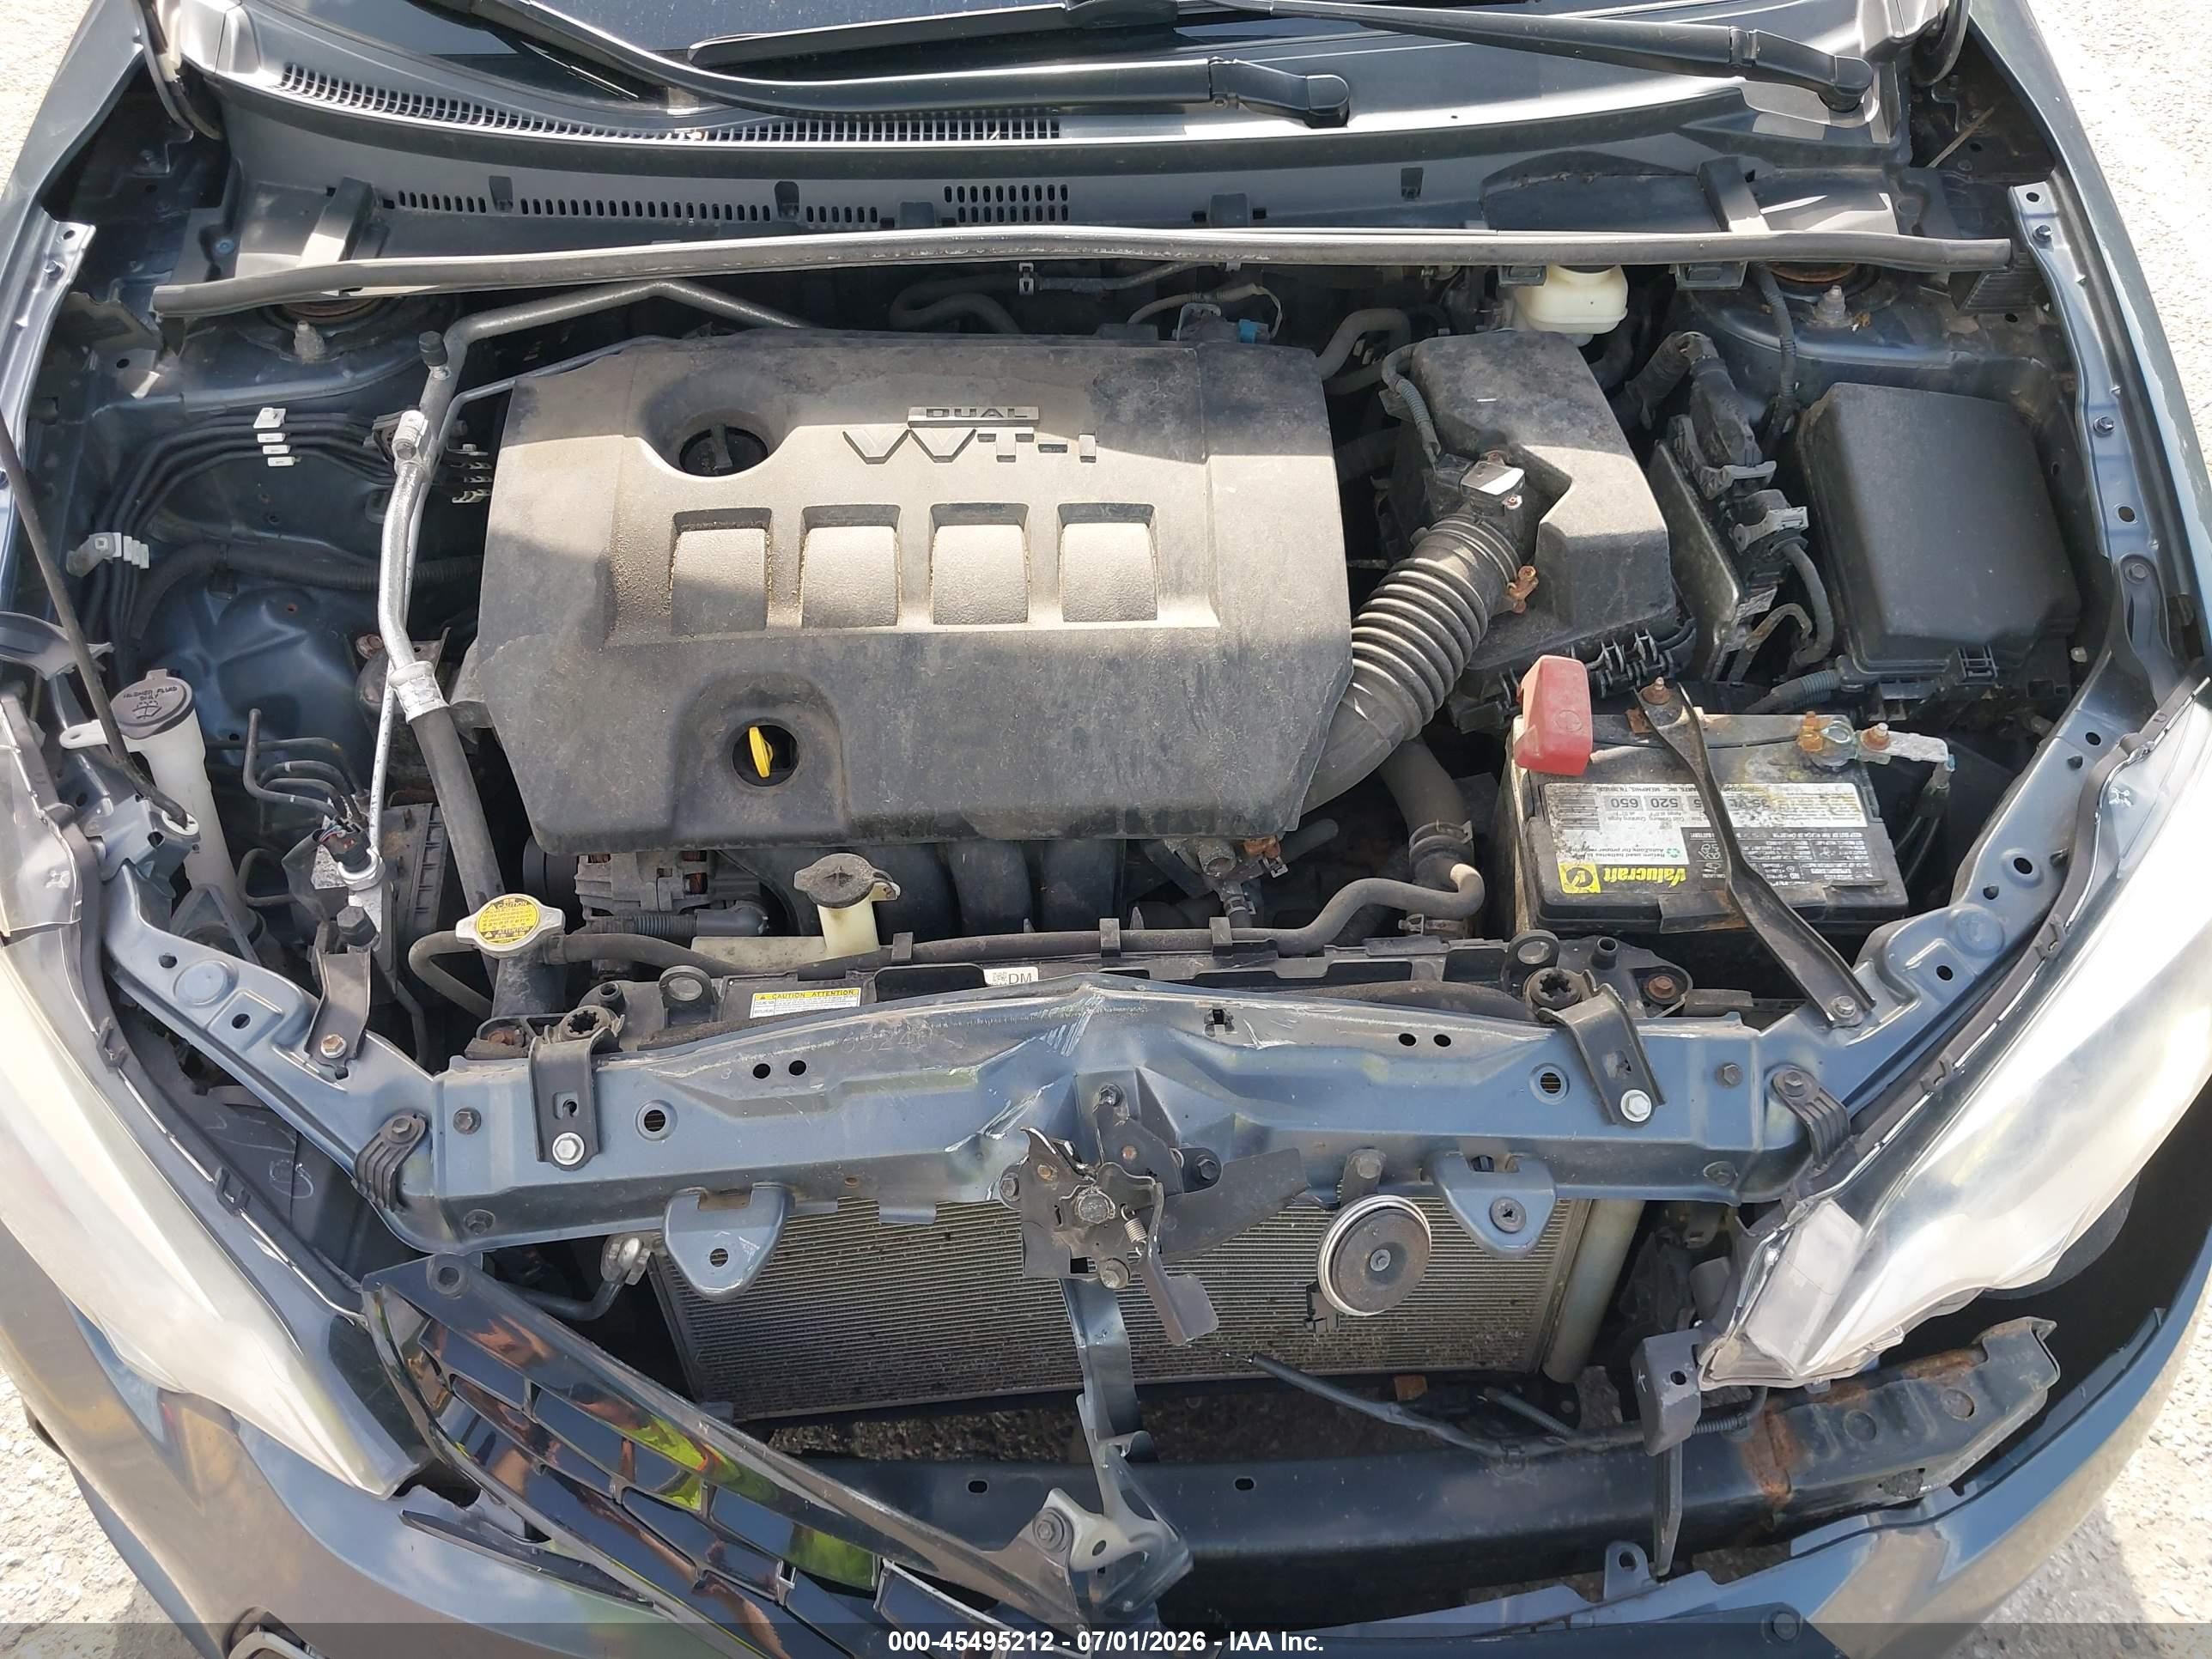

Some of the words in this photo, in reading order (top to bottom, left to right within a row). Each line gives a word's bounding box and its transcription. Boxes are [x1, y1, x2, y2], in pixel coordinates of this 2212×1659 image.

[926, 407, 1029, 418] DUAL
[1610, 798, 1639, 808] 650
[1650, 798, 1679, 808] 520
[1603, 867, 1686, 888] Valucraft
[1008, 973, 1031, 985] DM
[811, 988, 854, 998] ATTENTION
